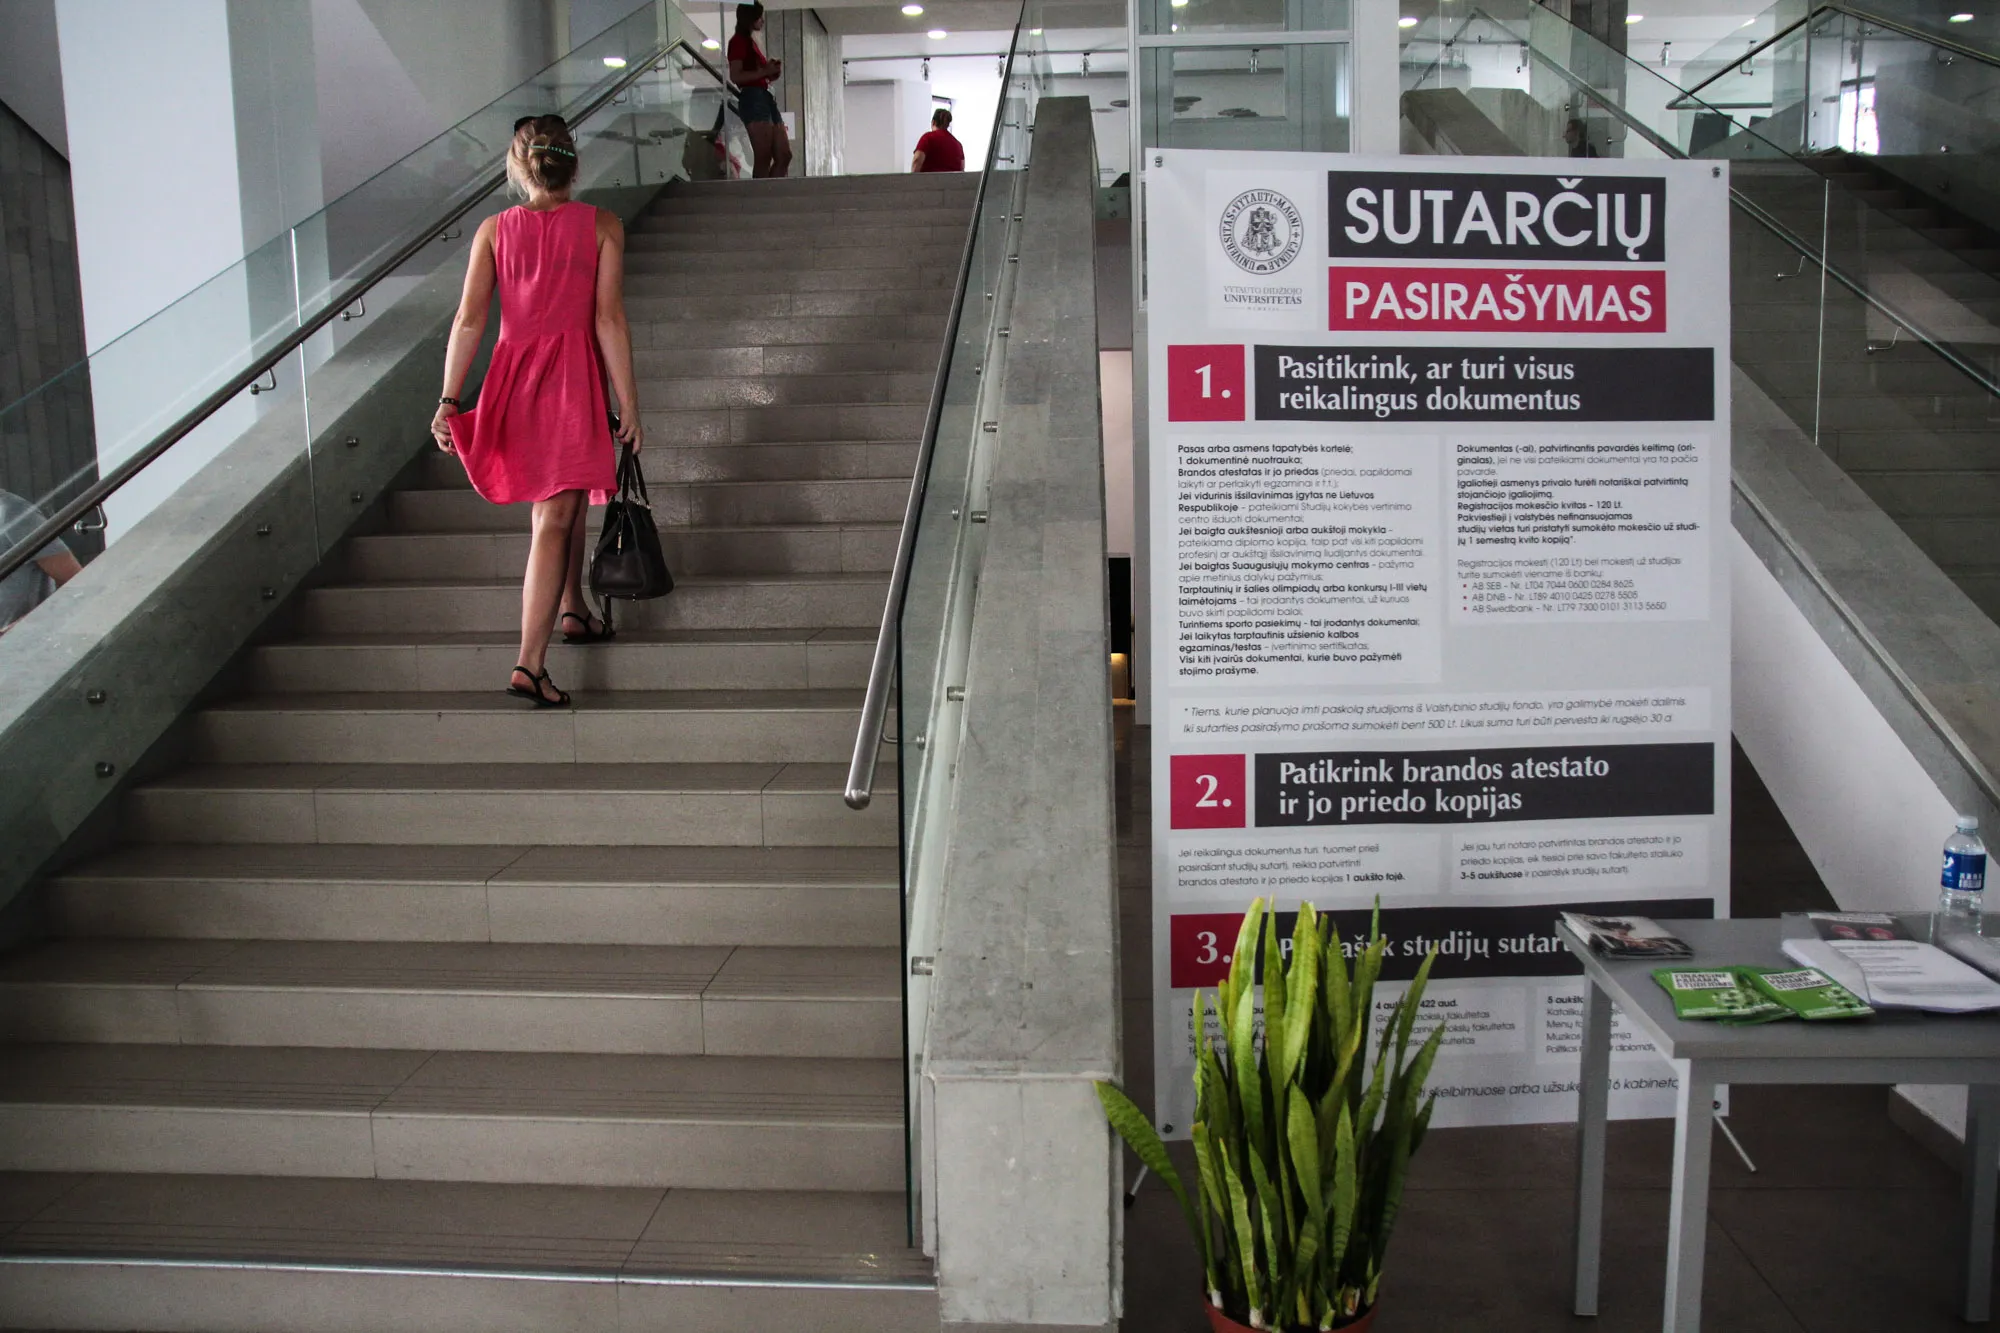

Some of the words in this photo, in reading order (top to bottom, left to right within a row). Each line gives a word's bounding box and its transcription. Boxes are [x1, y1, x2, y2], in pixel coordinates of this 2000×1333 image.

[1233, 192, 1274, 212] VYTAUTI
[1276, 198, 1300, 228] MAGNI
[1344, 177, 1651, 261] SUTARČIŲ
[1223, 212, 1256, 271] UNIVERSITAS
[1223, 285, 1262, 294] VYTAUTO
[1224, 294, 1302, 305] UNIVERSITETAS
[1345, 274, 1653, 322] PASIRAŠYMAS
[1278, 355, 1418, 383] Pasitikrink,
[1426, 361, 1453, 380] ar
[1461, 356, 1505, 380] turi
[1513, 357, 1575, 380] visus
[1194, 364, 1231, 399] 1.
[1279, 387, 1418, 417] reikalingus
[1426, 387, 1581, 411] dokumentus
[1177, 444, 1205, 453] Pasas
[1206, 444, 1230, 453] arba
[1232, 445, 1270, 453] asmens
[1271, 443, 1318, 454] tapatybės
[1456, 443, 1513, 453] Dokumentas
[1538, 443, 1595, 453] patvirtinantis
[1596, 443, 1640, 453] pavardės
[1178, 456, 1182, 465] 1
[1185, 455, 1249, 465] dokumentinė
[1177, 467, 1216, 477] Brandos
[1218, 467, 1262, 476] atestatas
[1264, 467, 1270, 476] ir
[1272, 467, 1282, 477] jo
[1283, 467, 1319, 477] priedas
[1499, 479, 1540, 488] asmenys
[1540, 478, 1572, 488] privalo
[1573, 477, 1597, 487] turėti
[1598, 477, 1642, 486] notariškai
[1178, 491, 1192, 500] Jei
[1194, 491, 1232, 500] vidurinis
[1234, 490, 1294, 500] išsilavinimas
[1295, 490, 1324, 501] įgytas
[1325, 491, 1337, 499] ne
[1339, 490, 1374, 500] Lietuvos
[1456, 489, 1507, 500] stojančiojo
[1178, 502, 1239, 513] Respublikoje
[1457, 501, 1513, 512] Registracijos
[1514, 500, 1559, 510] mokesčio
[1560, 500, 1587, 509] kvitas
[1596, 500, 1612, 509] 120
[1456, 512, 1507, 523] Pakviestieji
[1513, 512, 1555, 522] valstybės
[1556, 511, 1633, 522] nefinansuojamas
[1178, 526, 1192, 536] Jei
[1194, 526, 1226, 537] baigta
[1227, 525, 1283, 536] aukštesnioji
[1285, 525, 1309, 534] arba
[1310, 524, 1346, 535] aukštoji
[1347, 525, 1387, 535] mokykla
[1457, 524, 1486, 534] studijų
[1487, 524, 1515, 533] vietas
[1516, 524, 1531, 533] turi
[1532, 523, 1570, 534] pristatyti
[1571, 523, 1616, 532] sumokėto
[1617, 522, 1662, 532] mokesčio
[1662, 521, 1674, 531] už
[1457, 537, 1466, 546] jų
[1469, 535, 1473, 544] 1
[1475, 535, 1517, 546] semestrą
[1518, 535, 1540, 544] kvito
[1178, 562, 1192, 571] Jei
[1194, 561, 1230, 573] baigtas
[1290, 560, 1334, 571] mokymo
[1335, 560, 1370, 569] centras
[1235, 585, 1241, 593] ir
[1243, 583, 1270, 593] šalies
[1321, 583, 1346, 593] arba
[1405, 582, 1428, 592] vietų
[1178, 596, 1237, 607] laimėtojams
[1178, 619, 1223, 629] Turintiems
[1224, 619, 1253, 629] sporto
[1254, 618, 1302, 629] pasiekimų
[1309, 618, 1322, 627] tai
[1323, 618, 1365, 628] įrodantys
[1178, 631, 1193, 641] Jei
[1194, 631, 1231, 642] laikytas
[1232, 630, 1285, 640] tarptautinis
[1286, 629, 1325, 639] užsienio
[1326, 629, 1359, 639] kalbos
[1178, 642, 1262, 654] egzaminas/testas
[1178, 655, 1195, 664] Visi
[1197, 654, 1211, 663] kiti
[1212, 654, 1243, 665] įvairūs
[1306, 652, 1331, 662] kurie
[1332, 652, 1357, 662] buvo
[1358, 651, 1402, 663] pažymėti
[1178, 666, 1213, 676] stojimo
[1214, 665, 1259, 676] prašyme.
[1280, 758, 1393, 785] Patikrink
[1403, 757, 1503, 784] brandos
[1511, 755, 1610, 779] atestato
[1195, 774, 1232, 808] 2.
[1280, 791, 1299, 815] ir
[1307, 790, 1332, 822] jo
[1341, 788, 1425, 821] priedo
[1435, 786, 1522, 819] kopijas
[1459, 870, 1476, 880] 3-5
[1476, 869, 1523, 880] aukštuose
[1196, 931, 1232, 964] 3.
[1403, 930, 1490, 961] studijų
[1420, 999, 1436, 1008] 422
[1509, 1083, 1540, 1095] arba
